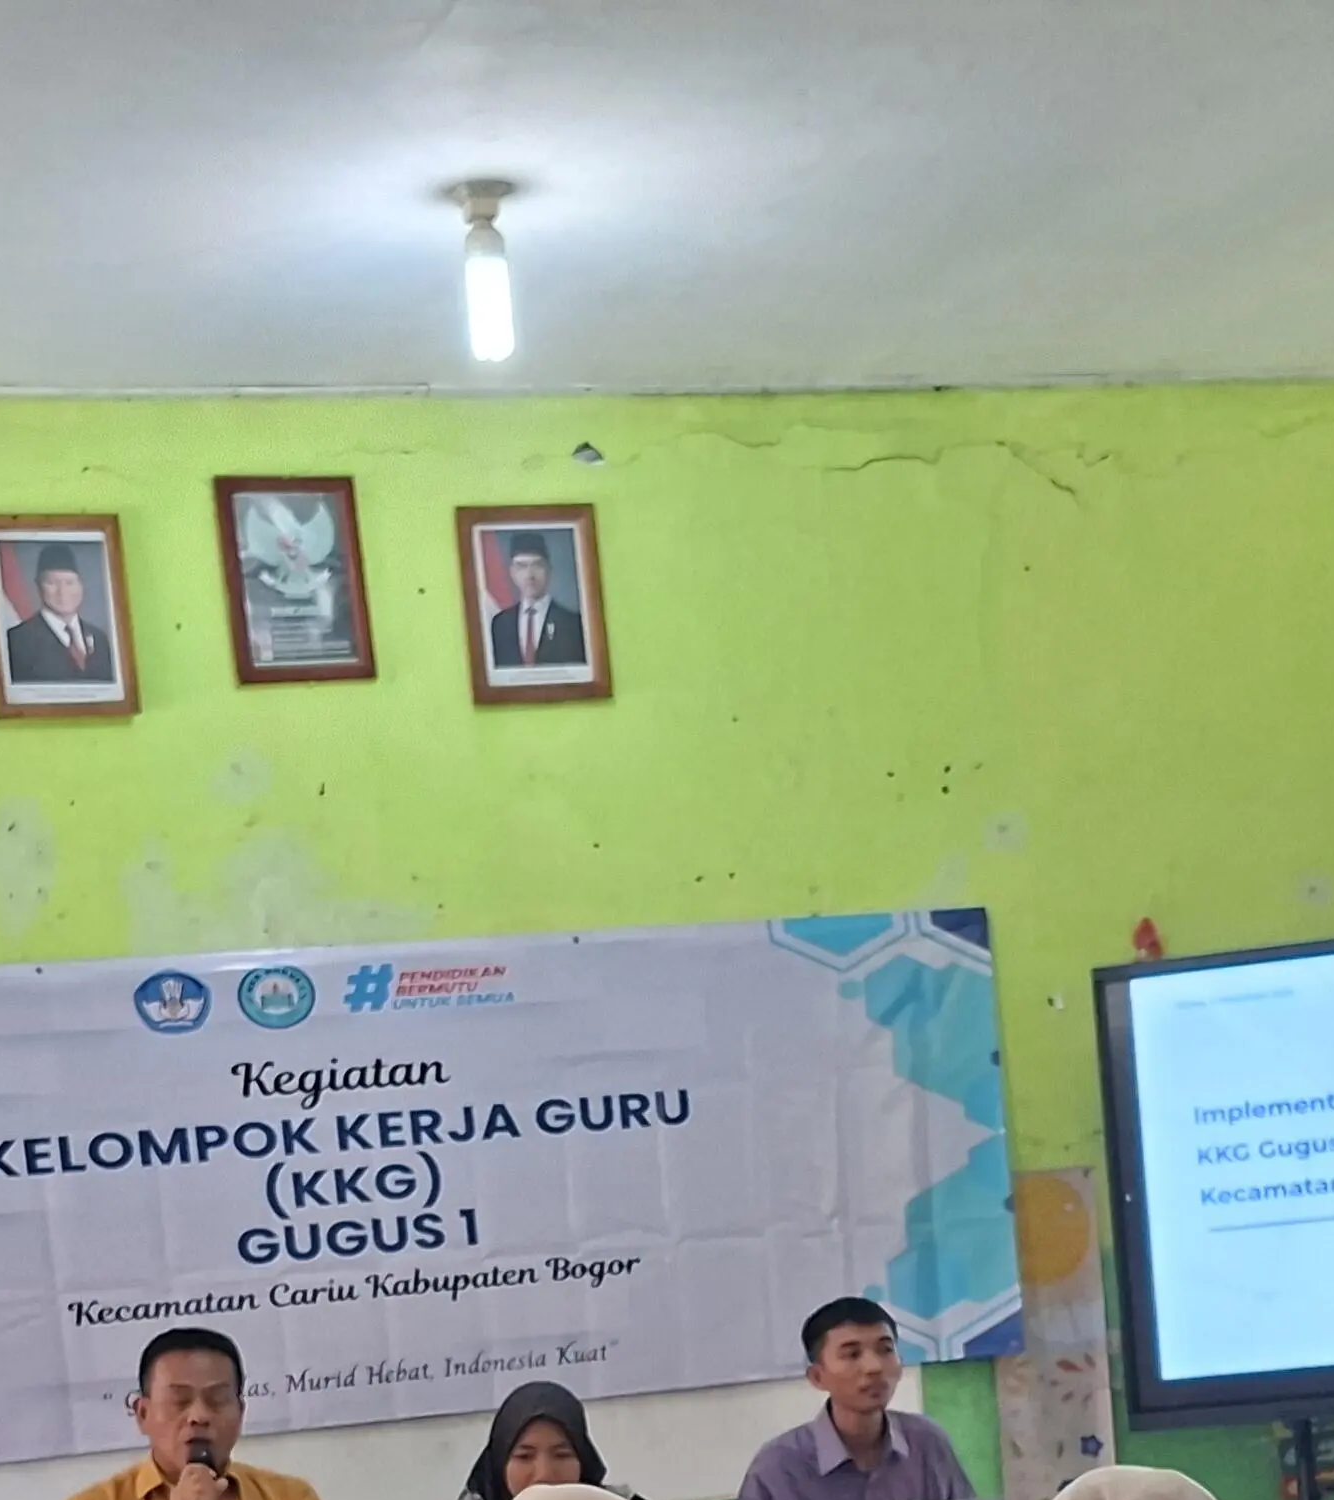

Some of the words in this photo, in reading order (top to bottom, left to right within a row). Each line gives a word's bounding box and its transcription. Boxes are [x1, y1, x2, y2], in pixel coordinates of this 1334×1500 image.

[230, 1057, 451, 1111] Kegiatan
[336, 1101, 522, 1153] KERJA
[535, 1087, 692, 1135] GURU
[1196, 1143, 1251, 1166] KKG
[265, 1151, 443, 1219] (KKG)
[237, 1214, 446, 1266] GUGUS
[459, 1208, 480, 1247] 1
[68, 1288, 260, 1328] Kecamatan
[267, 1276, 360, 1309] Cariu
[363, 1262, 538, 1303] Kabupaten
[544, 1252, 643, 1292] Bogor
[285, 1365, 356, 1395] Murid
[443, 1351, 547, 1379] Indonesia
